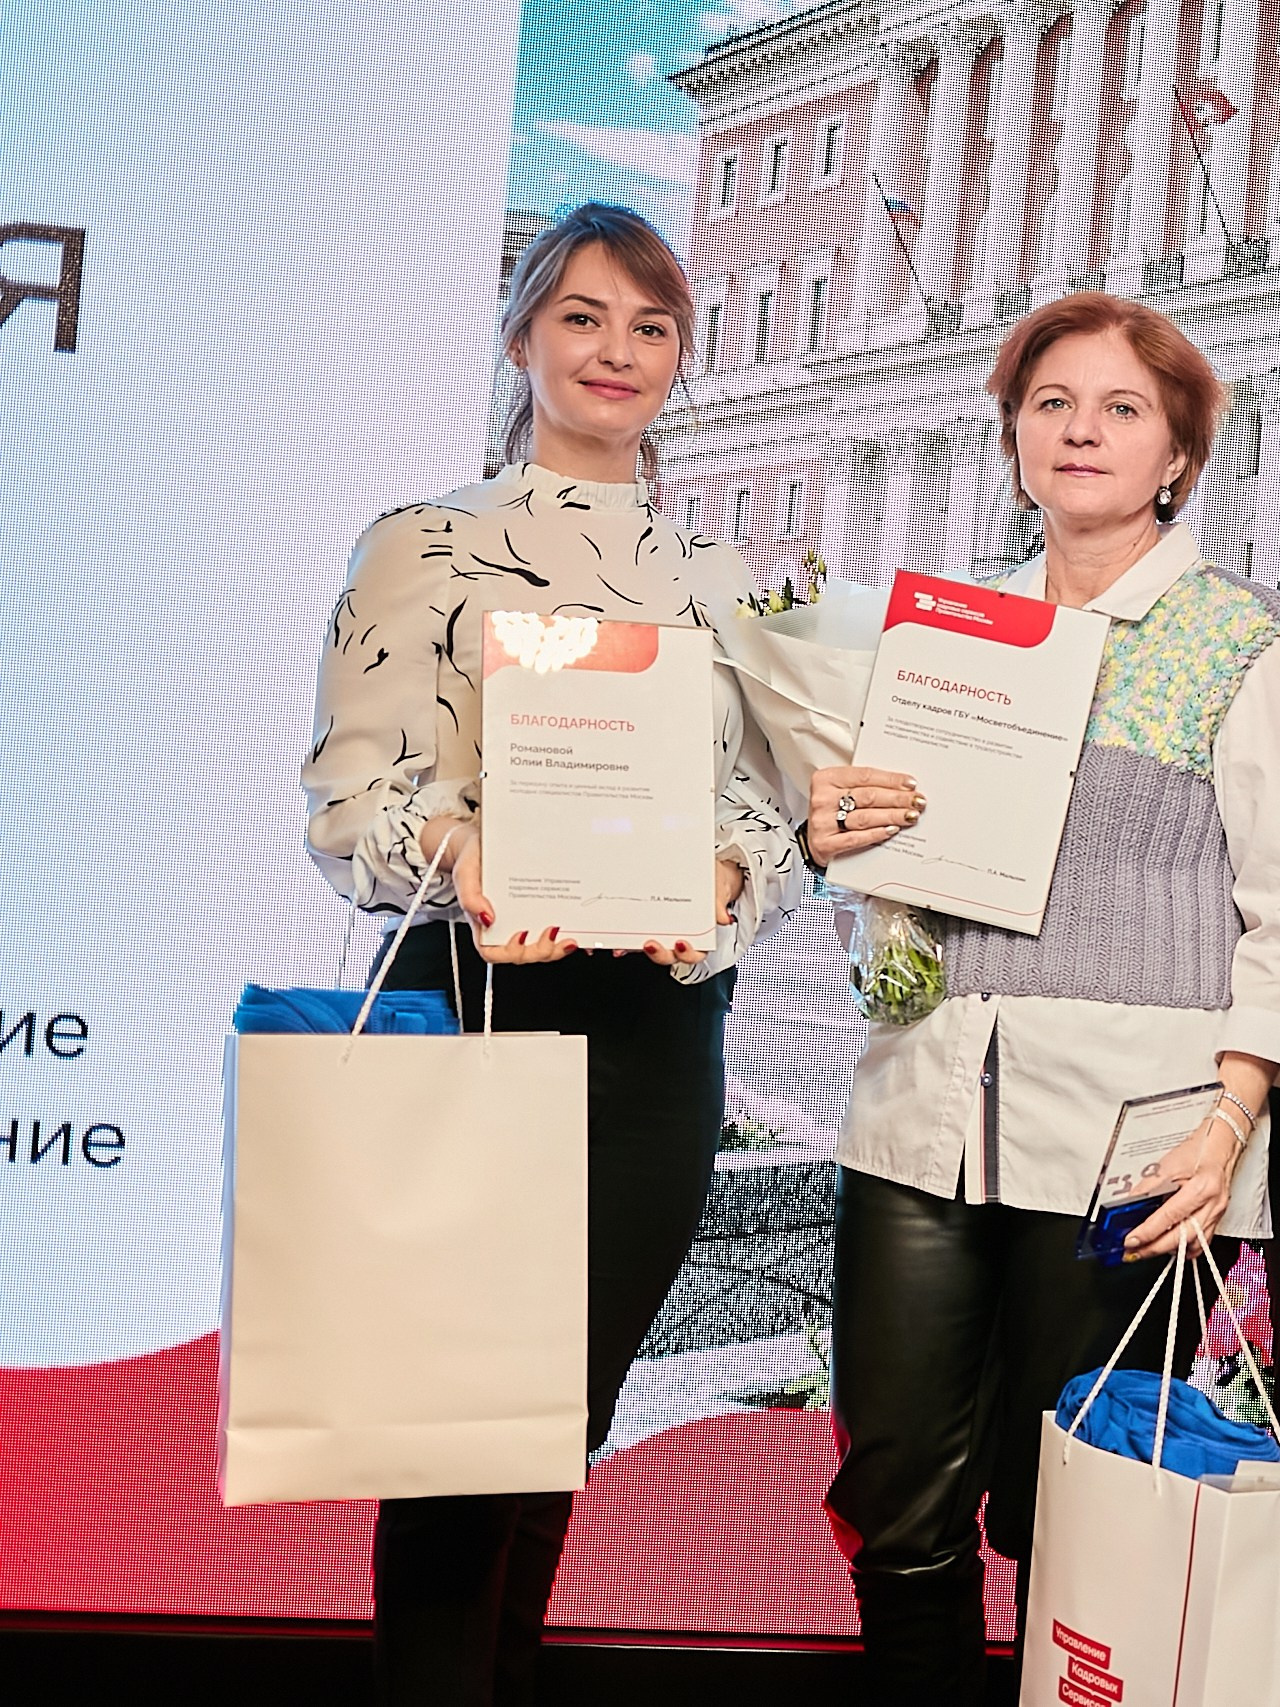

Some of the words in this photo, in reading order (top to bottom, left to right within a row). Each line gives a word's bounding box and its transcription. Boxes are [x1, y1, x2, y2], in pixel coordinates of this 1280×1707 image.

[897, 669, 1012, 705] БЛАГОДАРНОСТЬ
[891, 695, 921, 709] Отделу
[922, 703, 952, 715] кадров
[954, 709, 970, 719] ГБУ
[510, 714, 636, 732] БЛАГОДАРНОСТЬ
[510, 743, 573, 755] Романовой
[510, 757, 542, 767] Юлии
[545, 759, 630, 772] Владимировне
[1056, 1625, 1106, 1662] Управление
[1071, 1661, 1119, 1694] Кадровых
[1062, 1683, 1106, 1707] Сервис
